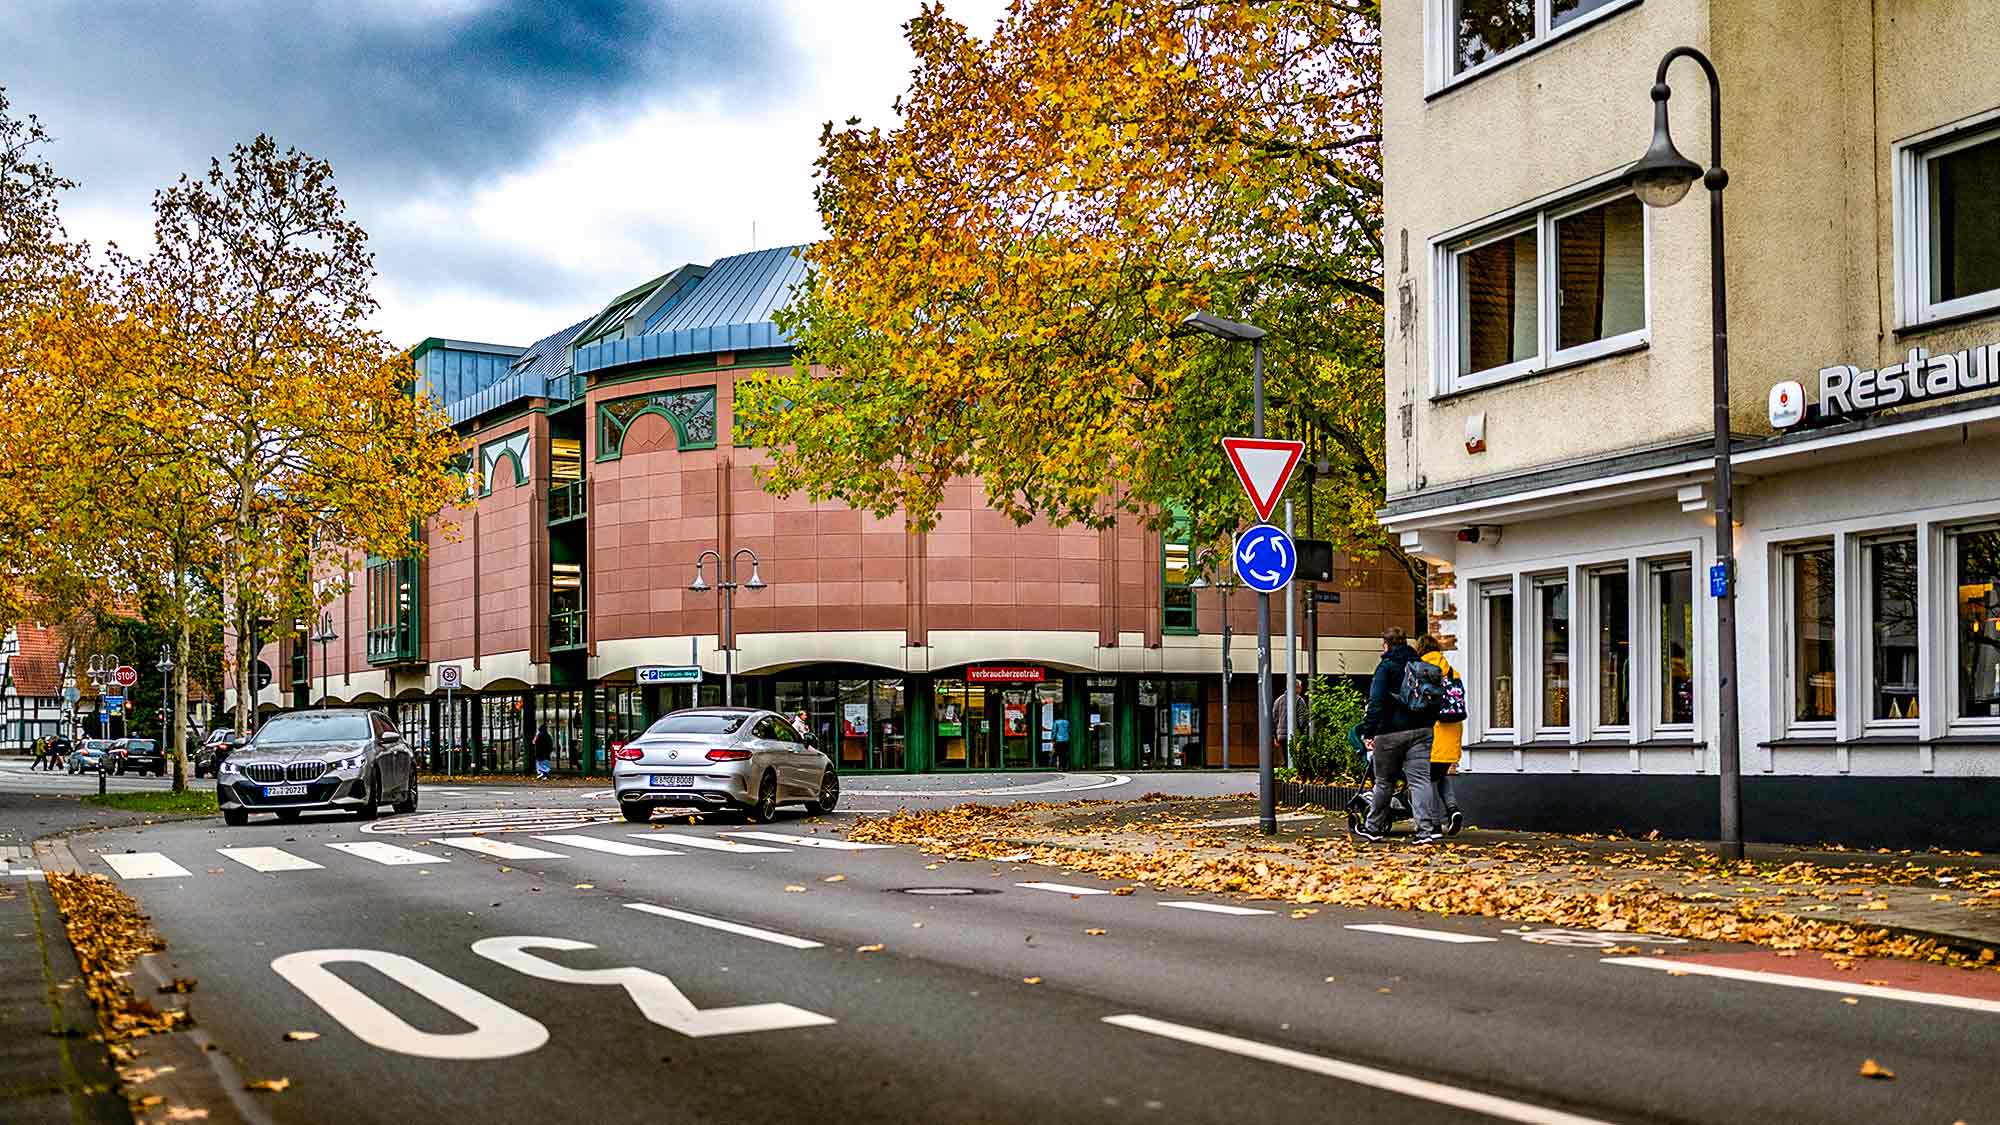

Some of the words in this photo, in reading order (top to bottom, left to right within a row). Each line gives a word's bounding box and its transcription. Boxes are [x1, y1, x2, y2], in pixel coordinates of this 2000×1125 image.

[117, 672, 135, 681] STOP
[445, 671, 454, 679] 30
[971, 669, 1040, 681] verbraucherzentrale
